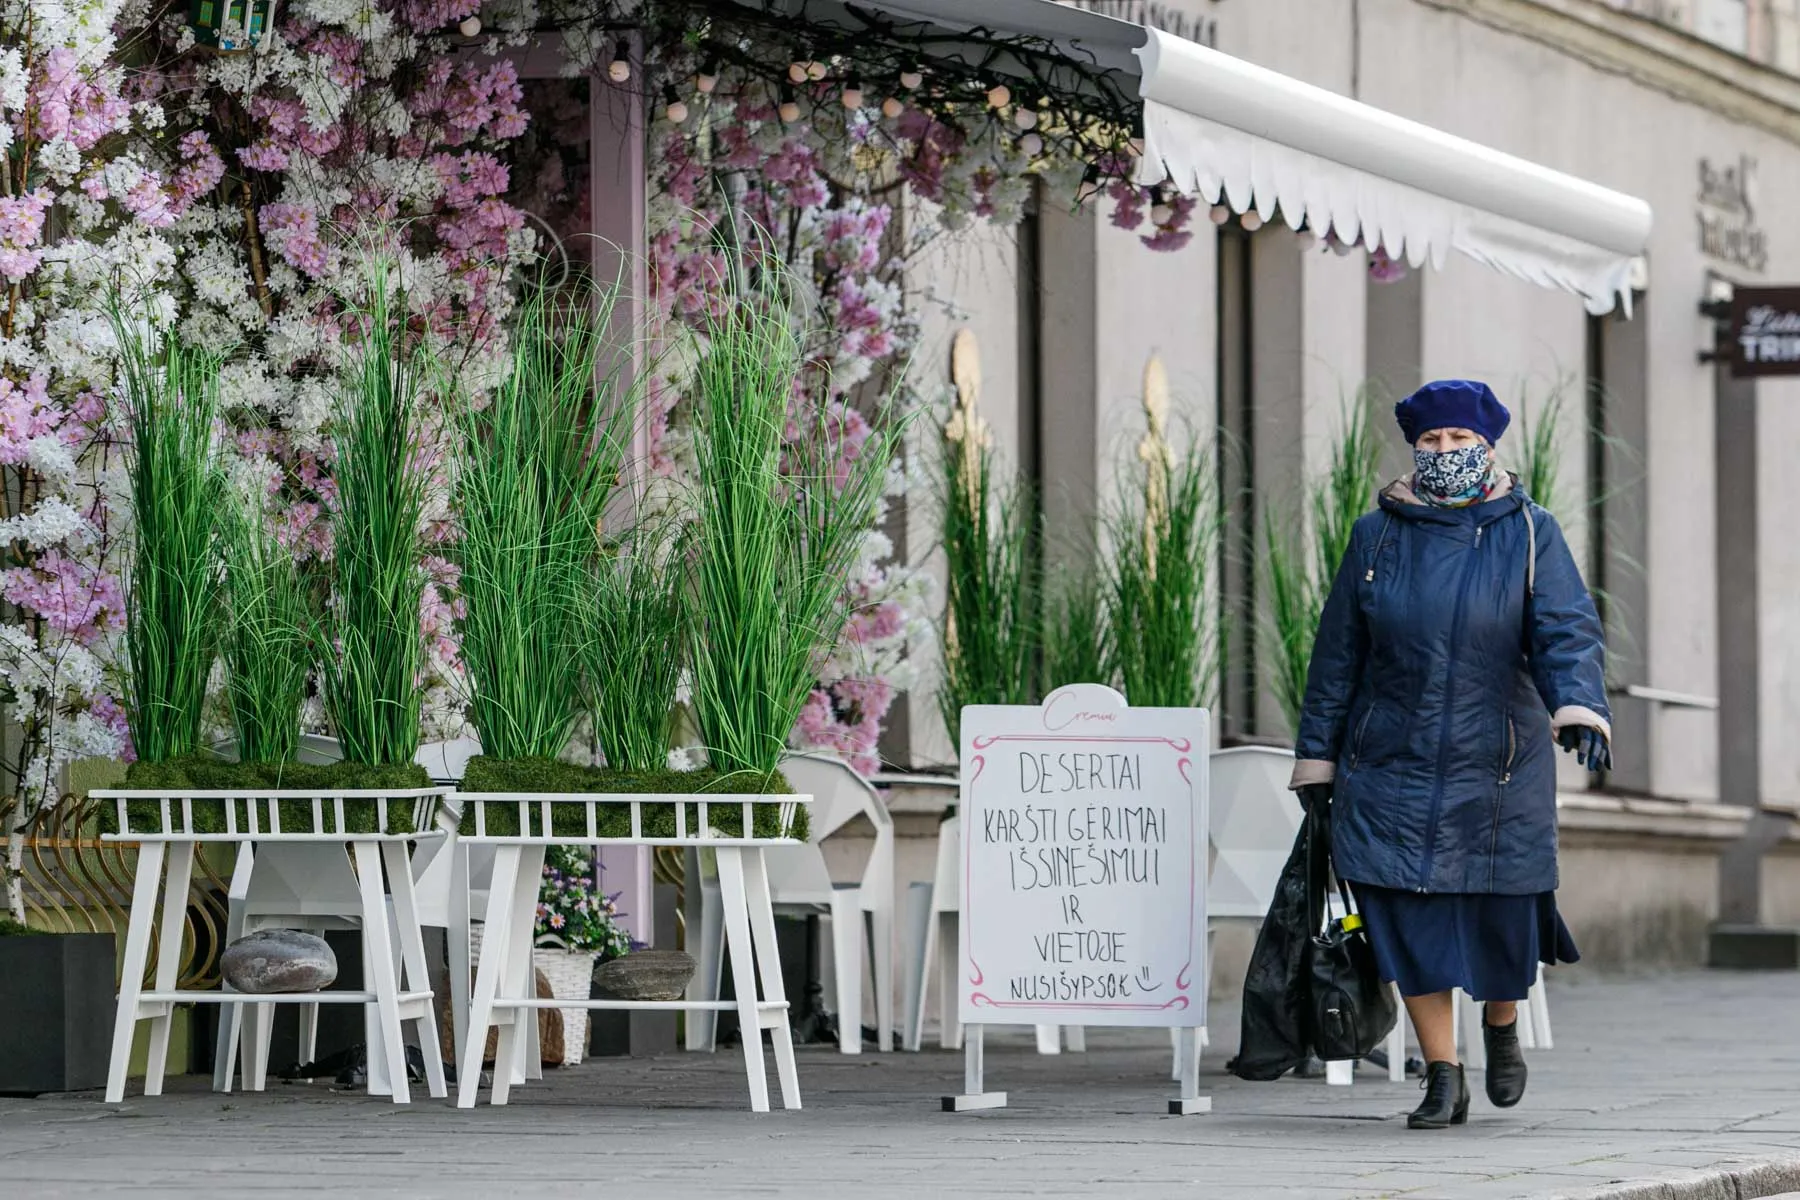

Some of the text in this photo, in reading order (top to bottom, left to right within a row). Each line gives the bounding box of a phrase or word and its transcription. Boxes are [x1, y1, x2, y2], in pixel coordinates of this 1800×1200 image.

[1018, 751, 1141, 794] DESERTAI
[983, 802, 1166, 844] KARŠTI GĖRIMAI
[1009, 842, 1159, 891] IŠSINEŠIMUI
[1061, 894, 1084, 925] IR
[1033, 929, 1127, 964] VIETOJE
[1010, 970, 1132, 1001] NUSIŠYPSOK
